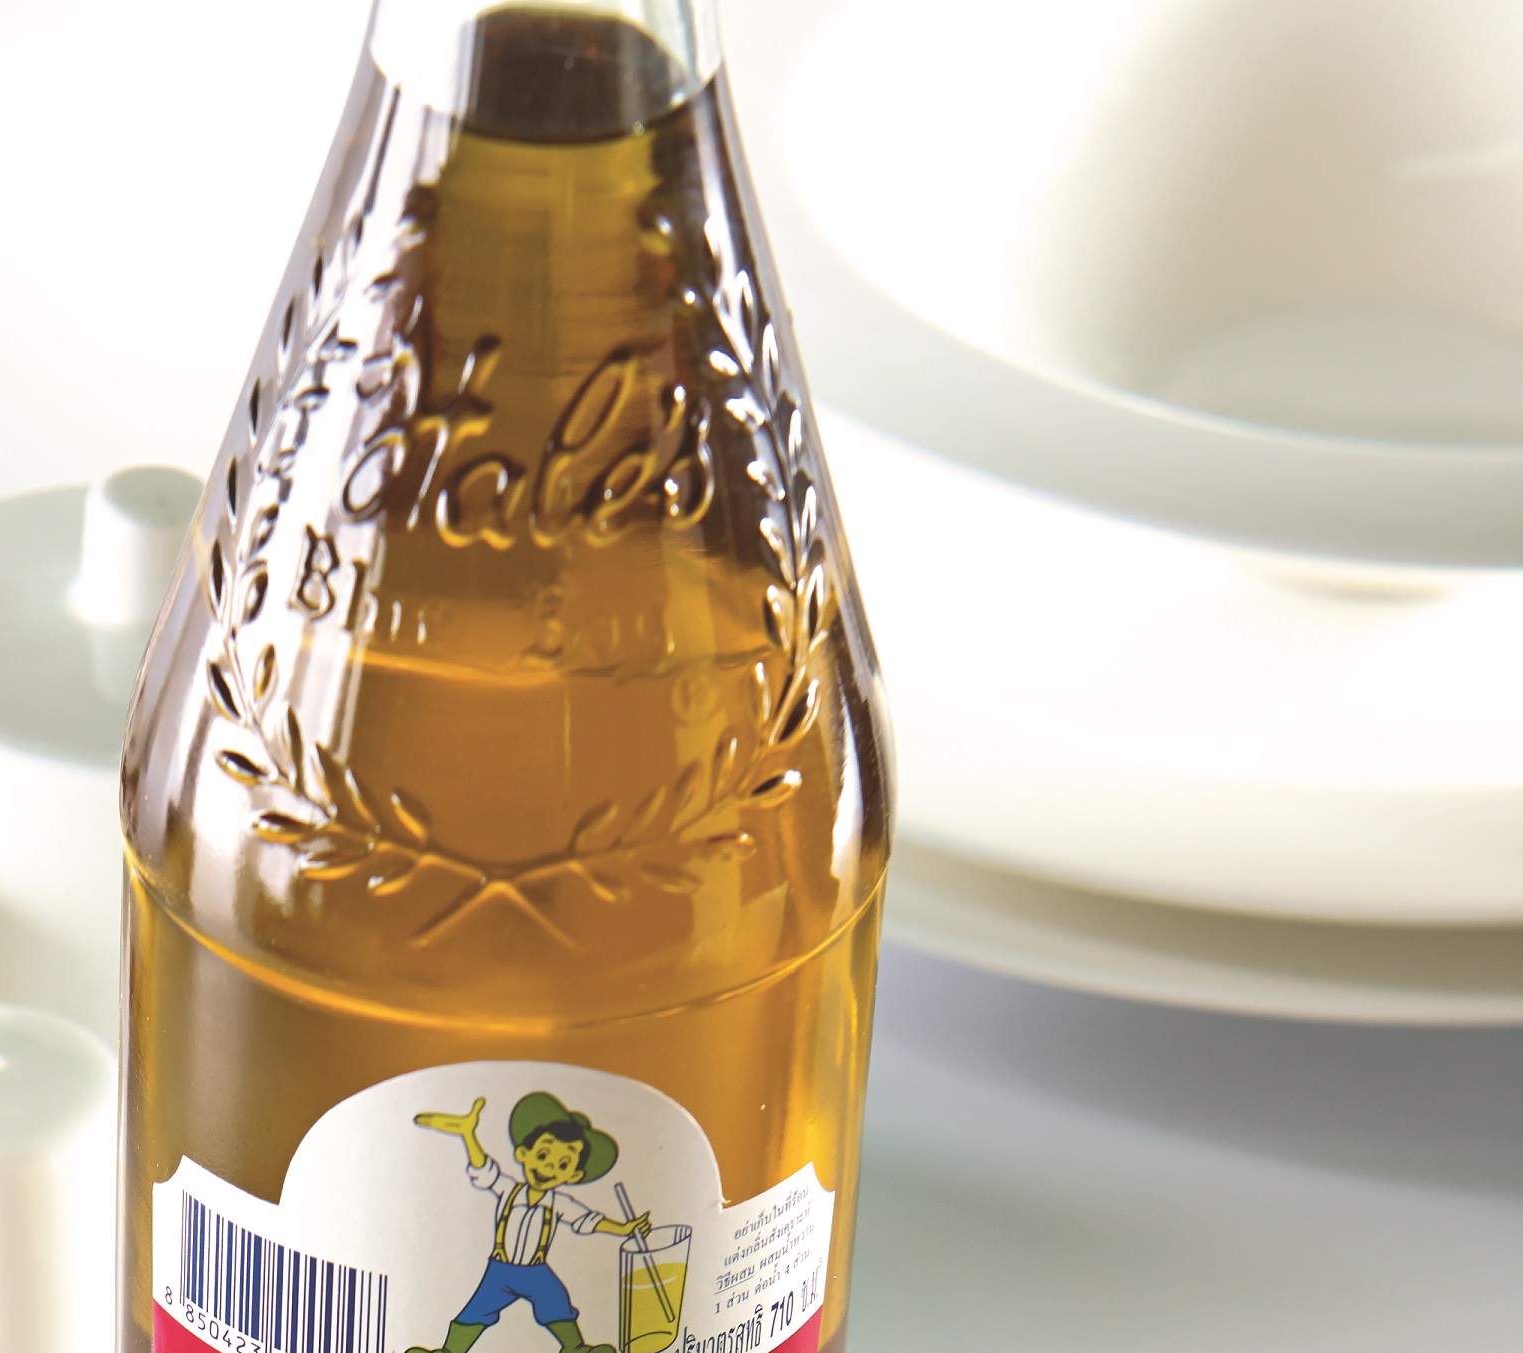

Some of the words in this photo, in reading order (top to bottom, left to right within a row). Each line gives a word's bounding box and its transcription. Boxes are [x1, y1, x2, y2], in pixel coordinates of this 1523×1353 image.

[165, 1286, 173, 1306] 8
[714, 1302, 720, 1314] 1
[784, 1263, 791, 1275] 4
[770, 1291, 795, 1338] 710
